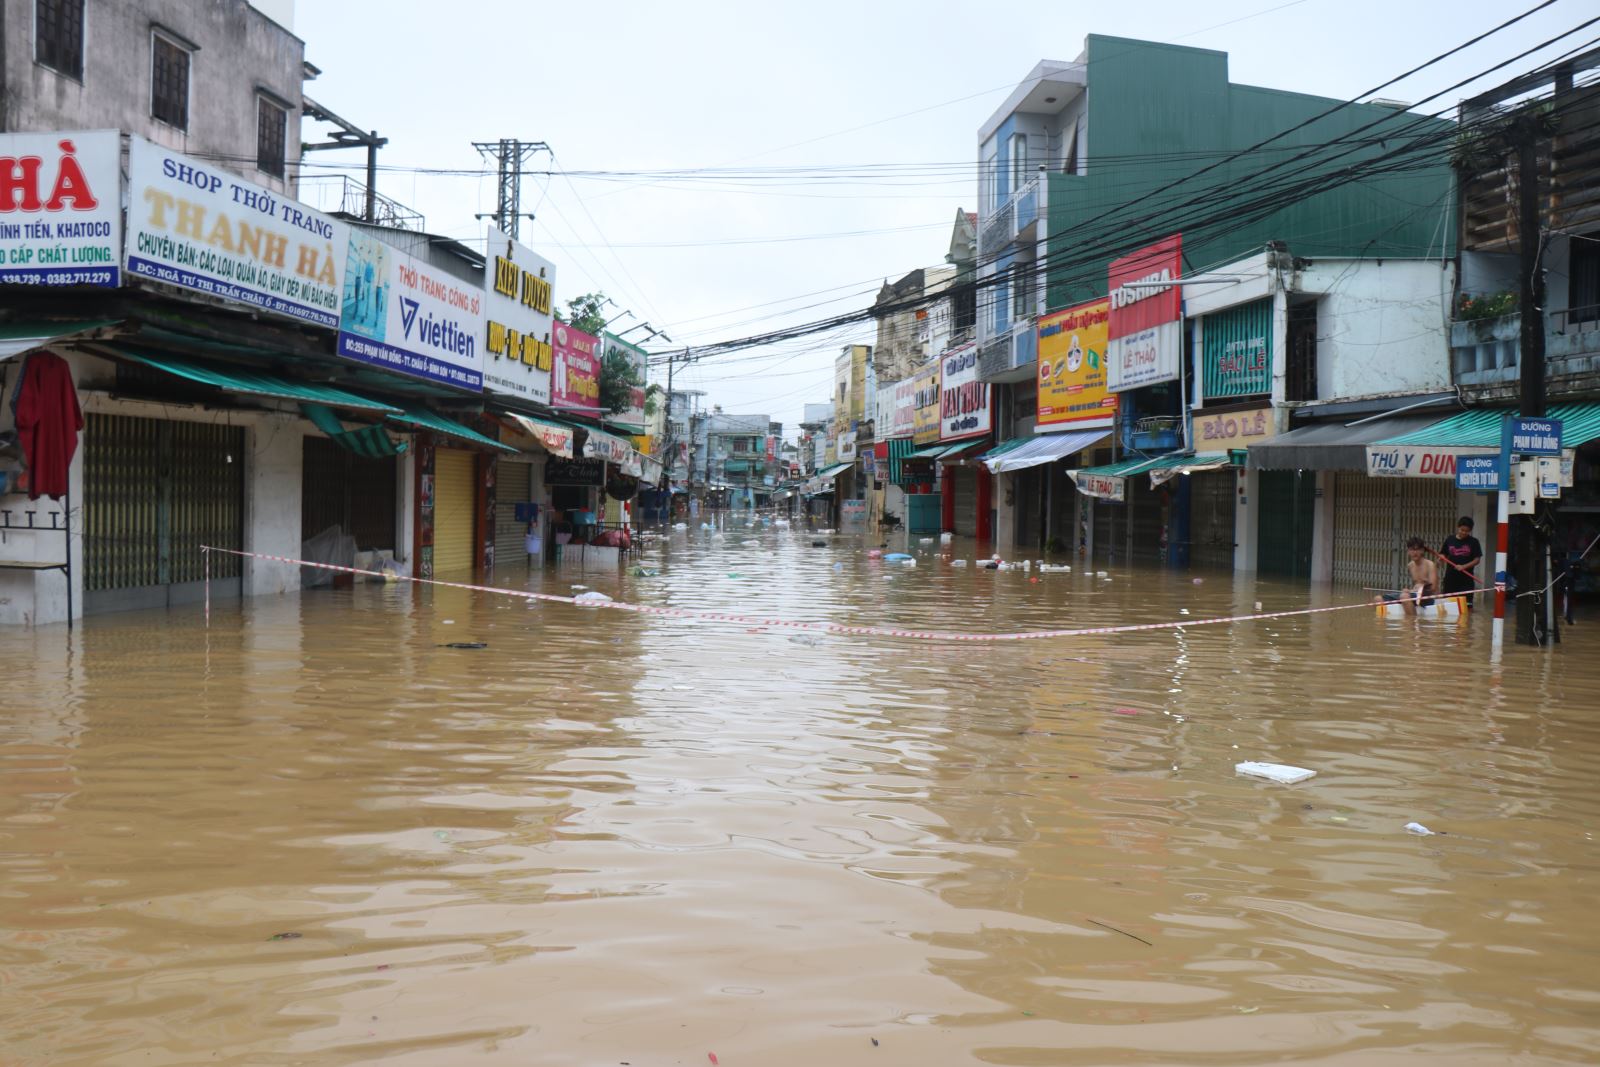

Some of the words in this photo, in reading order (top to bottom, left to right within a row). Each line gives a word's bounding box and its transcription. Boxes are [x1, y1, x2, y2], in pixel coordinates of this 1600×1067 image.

[0, 138, 99, 213] HÀ
[162, 158, 223, 194] SHOP
[230, 183, 276, 216] THỜI
[281, 204, 334, 240] TRANG
[57, 221, 110, 238] KHATOCO
[143, 185, 290, 269] THANH
[295, 240, 337, 286] HÀ
[10, 243, 33, 264] CẤP
[38, 242, 67, 263] CHẤT
[137, 231, 176, 261] CHUYÊN
[177, 241, 198, 268] BÁN:
[199, 248, 217, 272] CÁC
[217, 255, 236, 281] LOẠI
[157, 268, 180, 283] NGÃ
[182, 274, 196, 286] TƯ
[197, 279, 214, 292] THỊ
[215, 282, 240, 298] TRẤN
[241, 291, 264, 304] CHÂU
[420, 274, 447, 302] TRANG
[1110, 267, 1172, 310] TOSHIBA
[419, 312, 474, 358] viettien
[1241, 410, 1266, 436] LÊ
[1521, 421, 1552, 432] ĐƯỜNG
[1513, 435, 1530, 451] PHẠM
[1371, 449, 1399, 469] THÚ
[1404, 454, 1415, 469] Y
[1465, 457, 1493, 468] ĐƯỜNG
